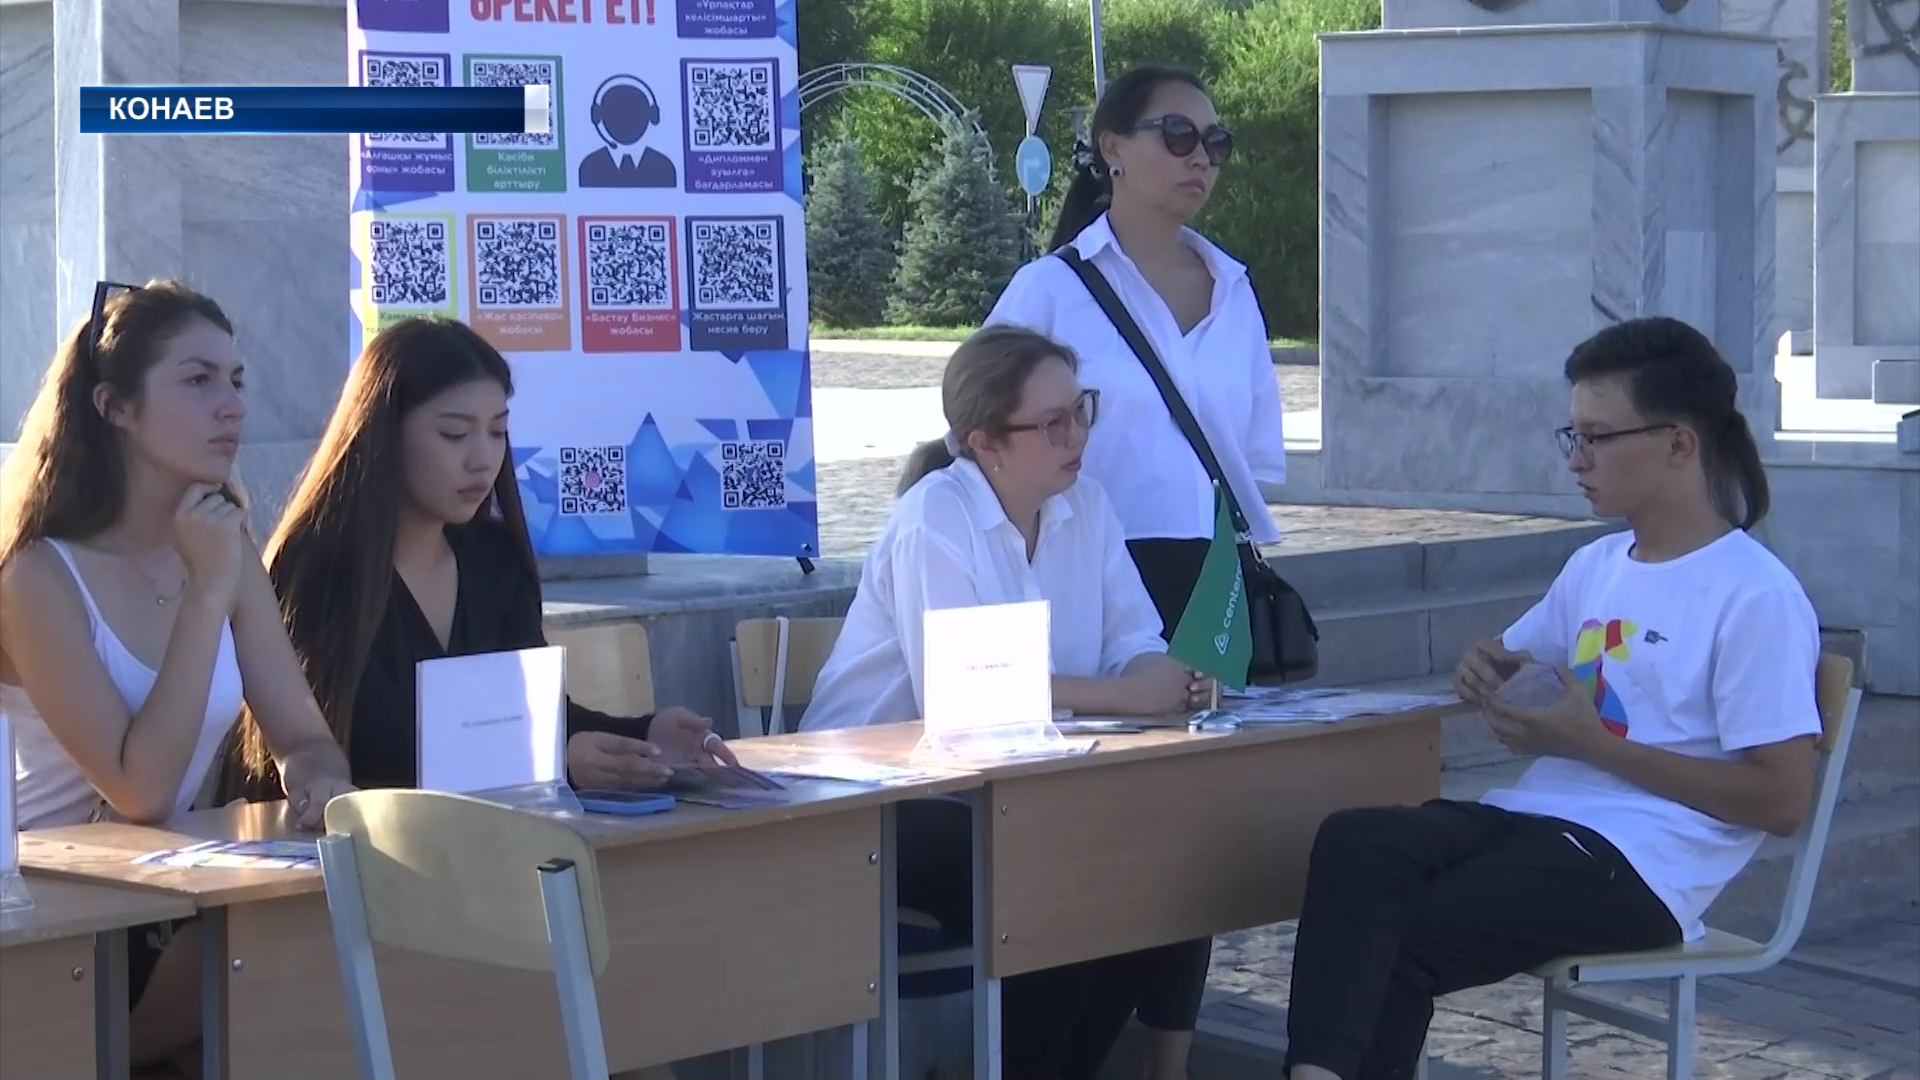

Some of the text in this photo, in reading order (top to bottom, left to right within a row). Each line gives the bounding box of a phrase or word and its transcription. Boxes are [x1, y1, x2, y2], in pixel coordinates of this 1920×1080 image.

[704, 25, 748, 36] жобасы
[401, 162, 446, 175] жобасы
[494, 180, 541, 190] арттыру
[585, 312, 677, 324] «Бастау Бизнес»
[499, 324, 543, 335] жобасы
[609, 324, 654, 336] жобасы
[741, 324, 769, 337] беру
